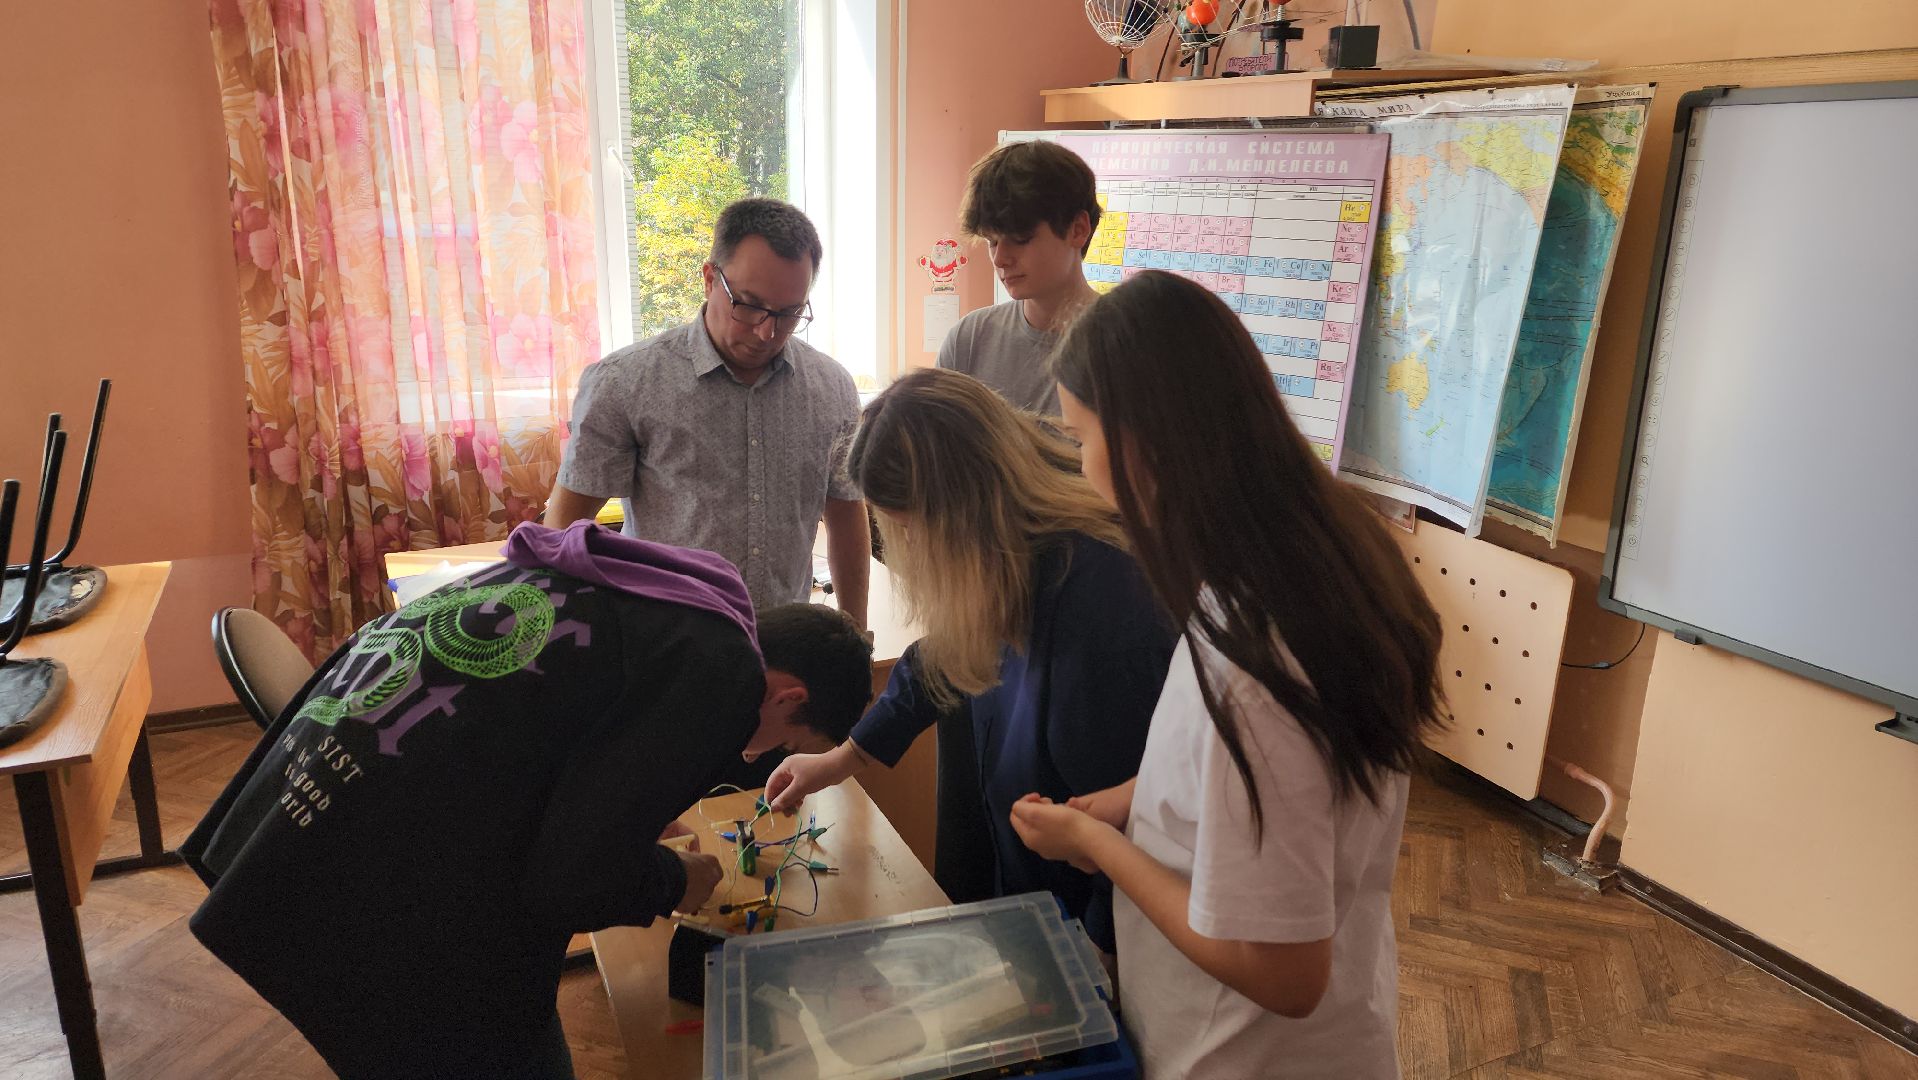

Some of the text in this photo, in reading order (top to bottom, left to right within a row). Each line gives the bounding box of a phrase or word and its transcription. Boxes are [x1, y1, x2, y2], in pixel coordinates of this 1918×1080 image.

[1331, 106, 1367, 117] КАРТА
[1377, 103, 1413, 115] МИРА
[1092, 140, 1335, 155] ПЕРИОДИЧЕСКАЯ СИСТЕМА
[1087, 158, 1348, 175] ЛЕМЕНТОВ Д.И.МЕНДЕЛЕЕВА
[318, 735, 363, 783] SIST
